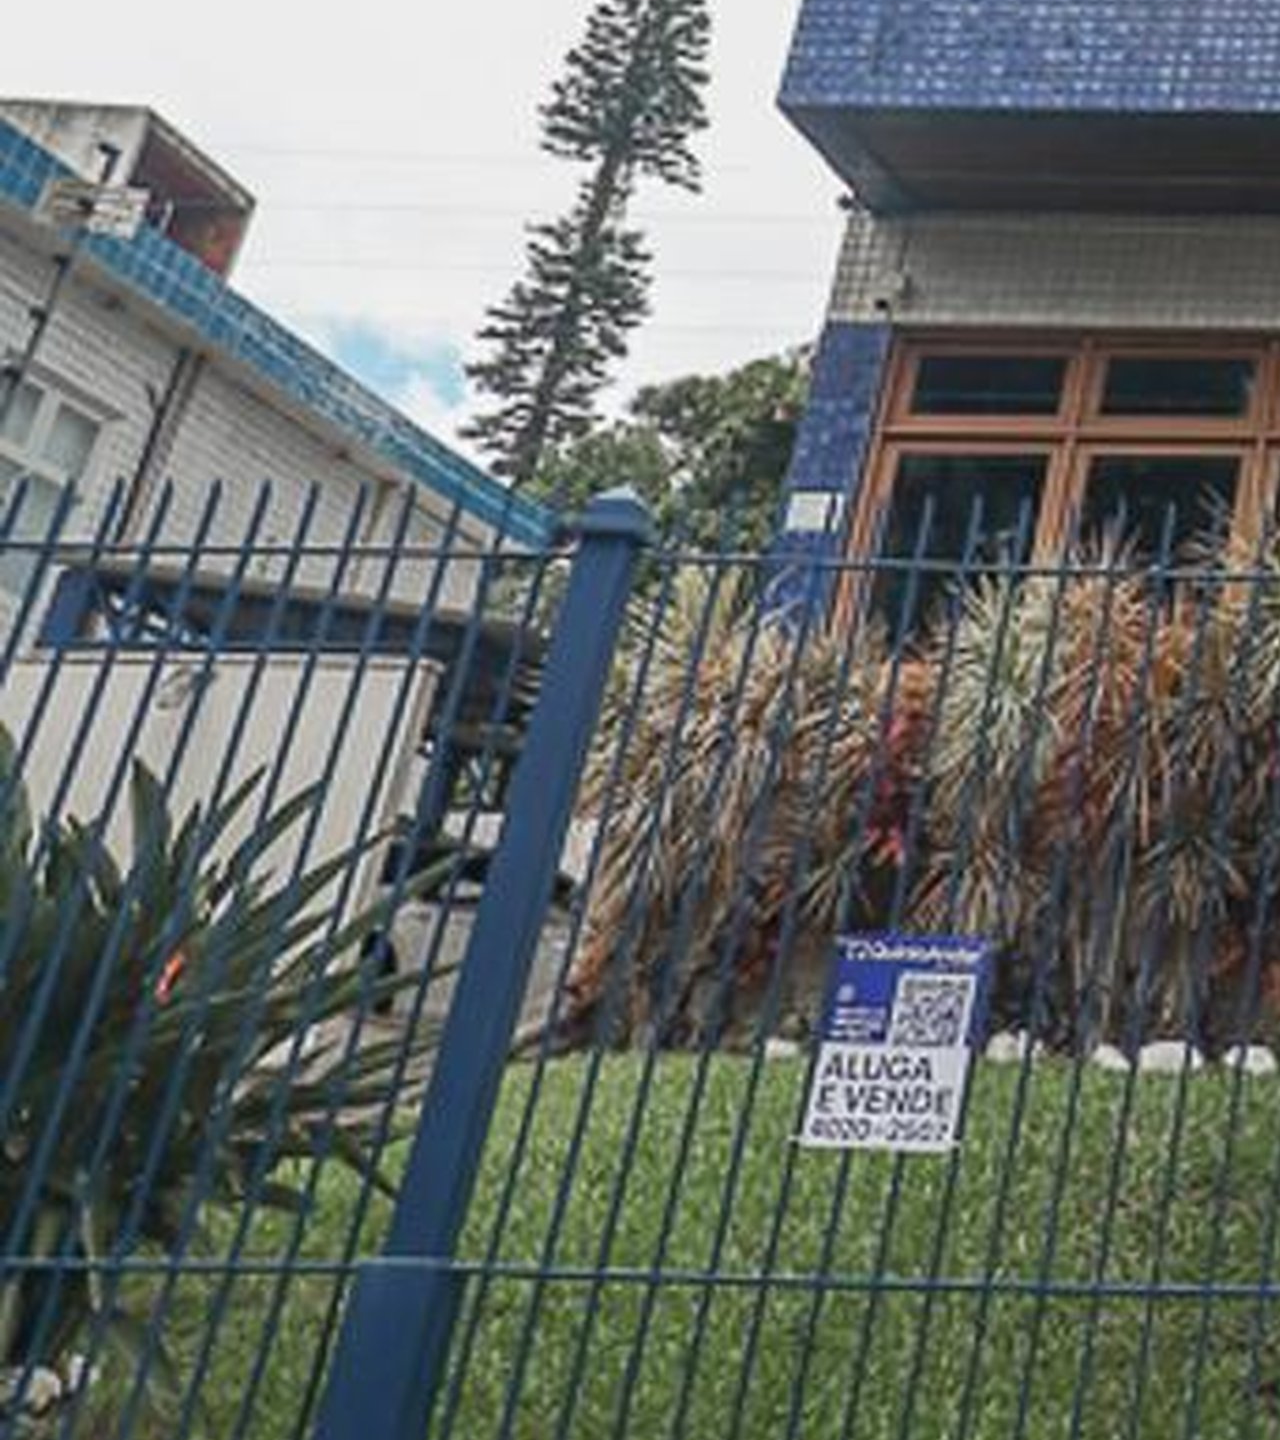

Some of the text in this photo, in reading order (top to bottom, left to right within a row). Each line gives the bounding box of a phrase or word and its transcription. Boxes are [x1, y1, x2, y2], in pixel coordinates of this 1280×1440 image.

[822, 1052, 932, 1082] ALUGA
[814, 1084, 953, 1116] E VENDE
